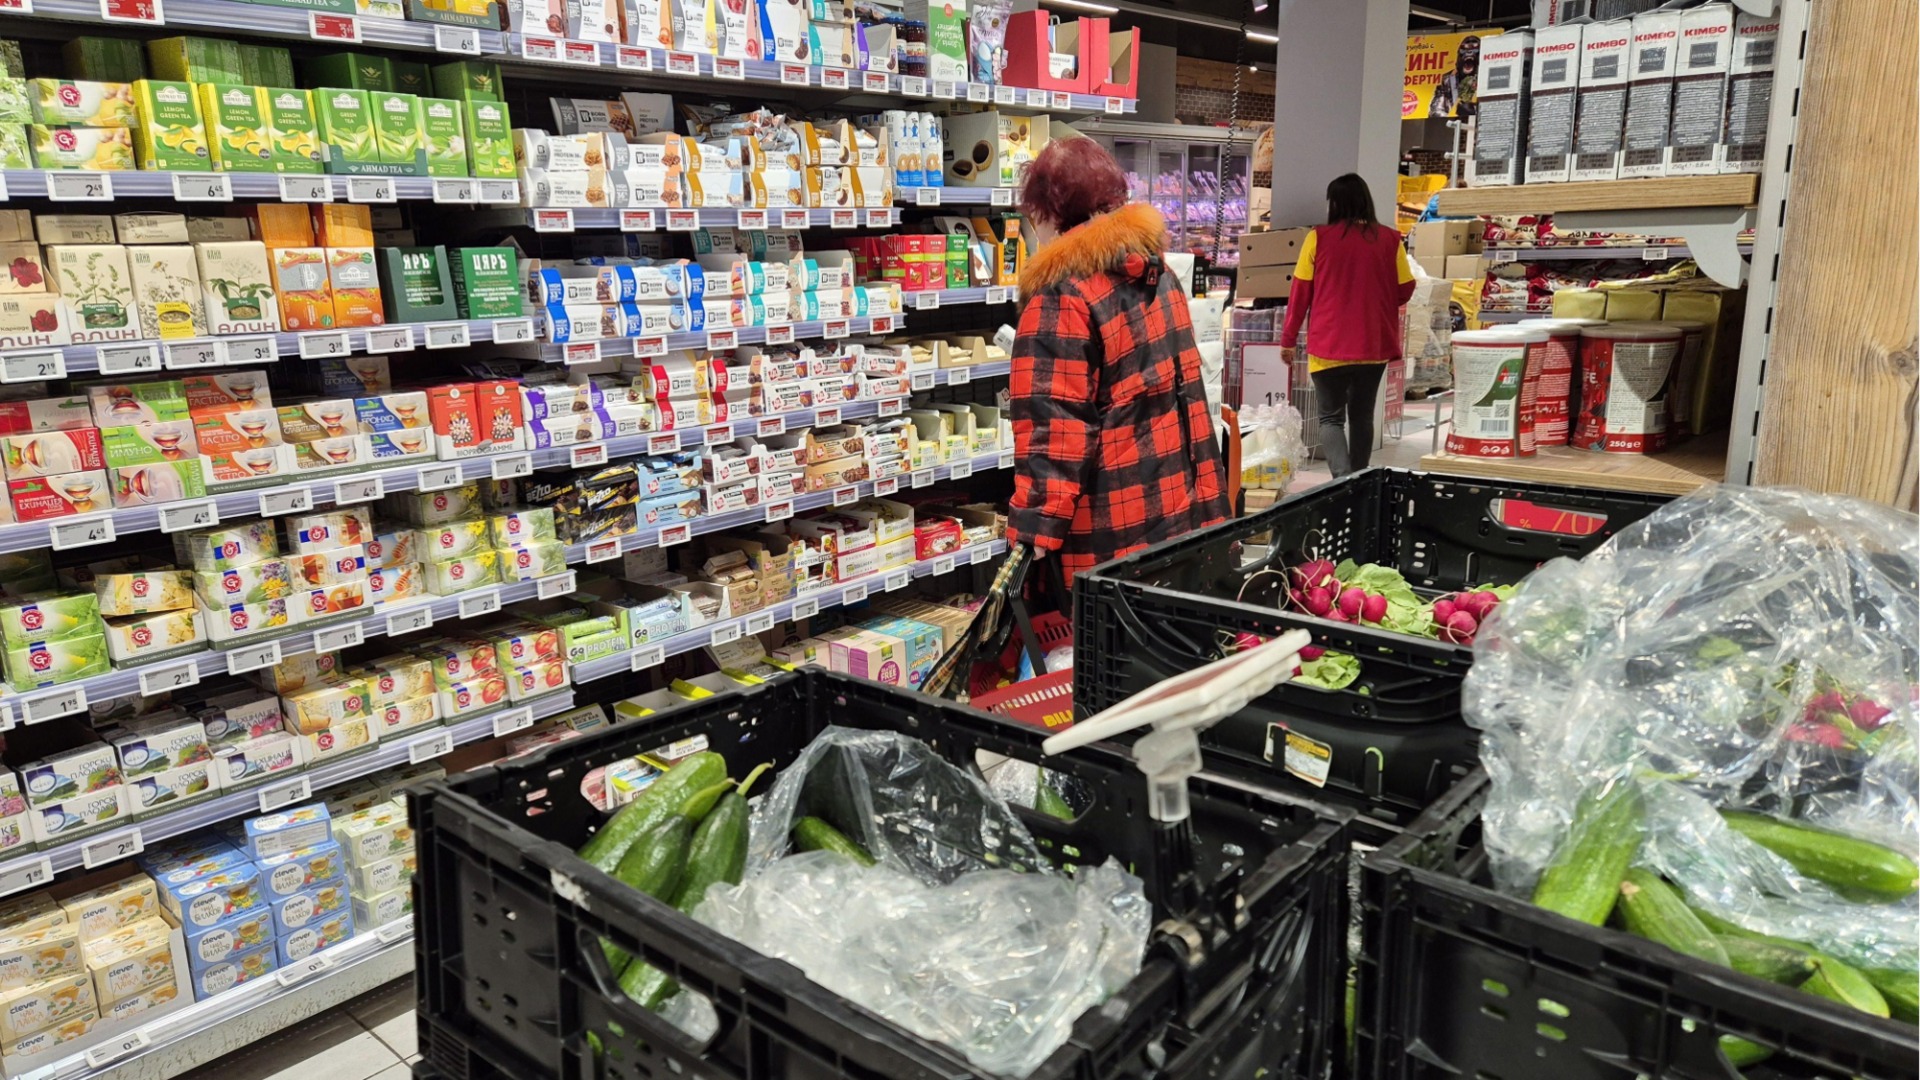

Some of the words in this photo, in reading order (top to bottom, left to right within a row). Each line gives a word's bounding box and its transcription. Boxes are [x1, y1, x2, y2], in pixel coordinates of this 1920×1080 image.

[439, 13, 462, 23] AHMAD
[463, 16, 478, 25] TEA
[1634, 31, 1676, 42] KIMBO
[1684, 26, 1728, 37] KIMBO
[1537, 43, 1576, 54] KIMBO
[1587, 38, 1627, 50] KIMBO
[1484, 50, 1518, 61] KIMBO
[361, 165, 387, 174] AHMAD
[388, 165, 403, 174] TEA
[403, 254, 430, 270] ЯРЪ
[472, 254, 506, 271] ЦЯРЪ
[188, 394, 228, 406] ГАСТРО
[202, 434, 240, 445] ГАСТРО
[109, 445, 152, 458] ИМУНО
[456, 444, 513, 457] BIOPROGRAMME
[191, 462, 203, 497] ИМУНО
[1520, 518, 1531, 528] %
[650, 618, 686, 634] PROTEIN
[588, 636, 624, 654] PROTEIN
[880, 668, 897, 680] FREE
[1042, 710, 1073, 727] BILL
[362, 834, 383, 845] clever
[275, 866, 297, 878] clever
[373, 864, 393, 875] clever
[193, 895, 216, 908] clever
[285, 899, 306, 910] clever
[378, 897, 397, 909] clever
[82, 906, 108, 919] clever
[202, 932, 226, 945] clever
[289, 931, 311, 944] clever
[0, 956, 23, 967] lever
[109, 963, 135, 978] clever
[206, 965, 230, 978] clever
[10, 1000, 38, 1014] clever
[114, 998, 140, 1013] clever
[17, 1035, 45, 1050] clever
